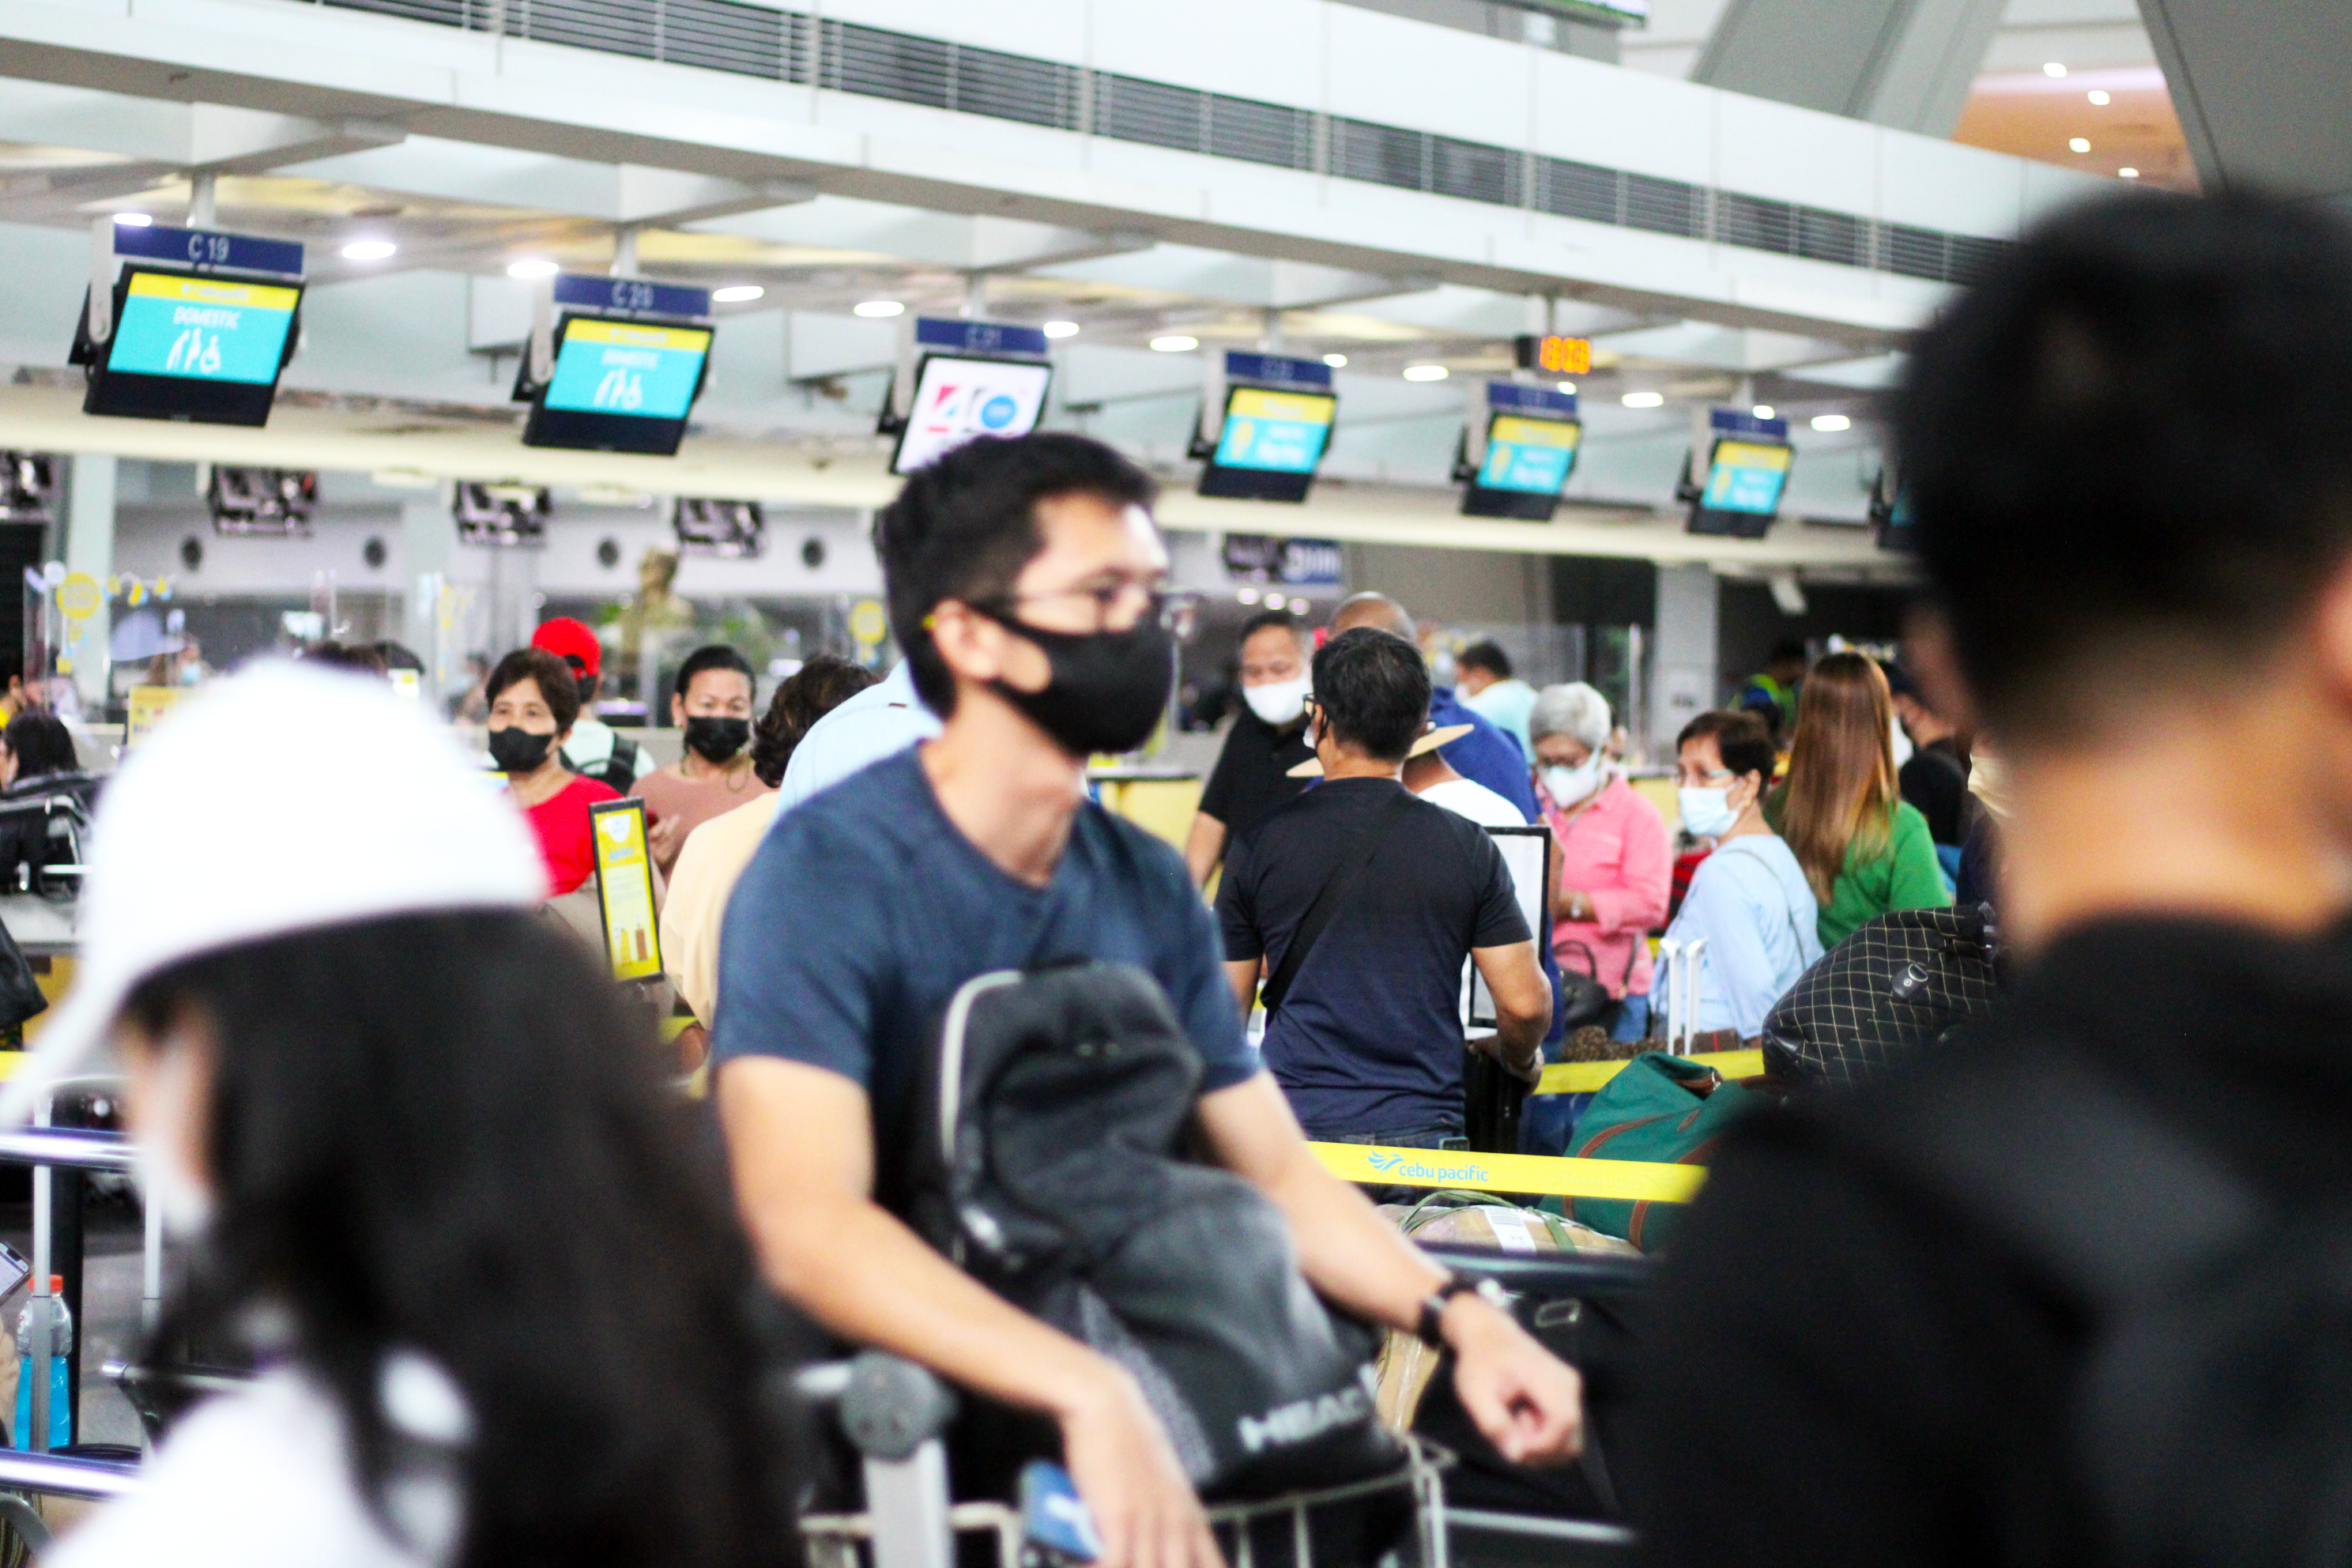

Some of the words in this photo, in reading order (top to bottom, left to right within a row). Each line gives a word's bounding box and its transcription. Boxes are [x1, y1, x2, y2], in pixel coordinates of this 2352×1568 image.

[187, 234, 203, 260] C
[1399, 1162, 1434, 1178] cebu
[1438, 1165, 1489, 1182] pacific
